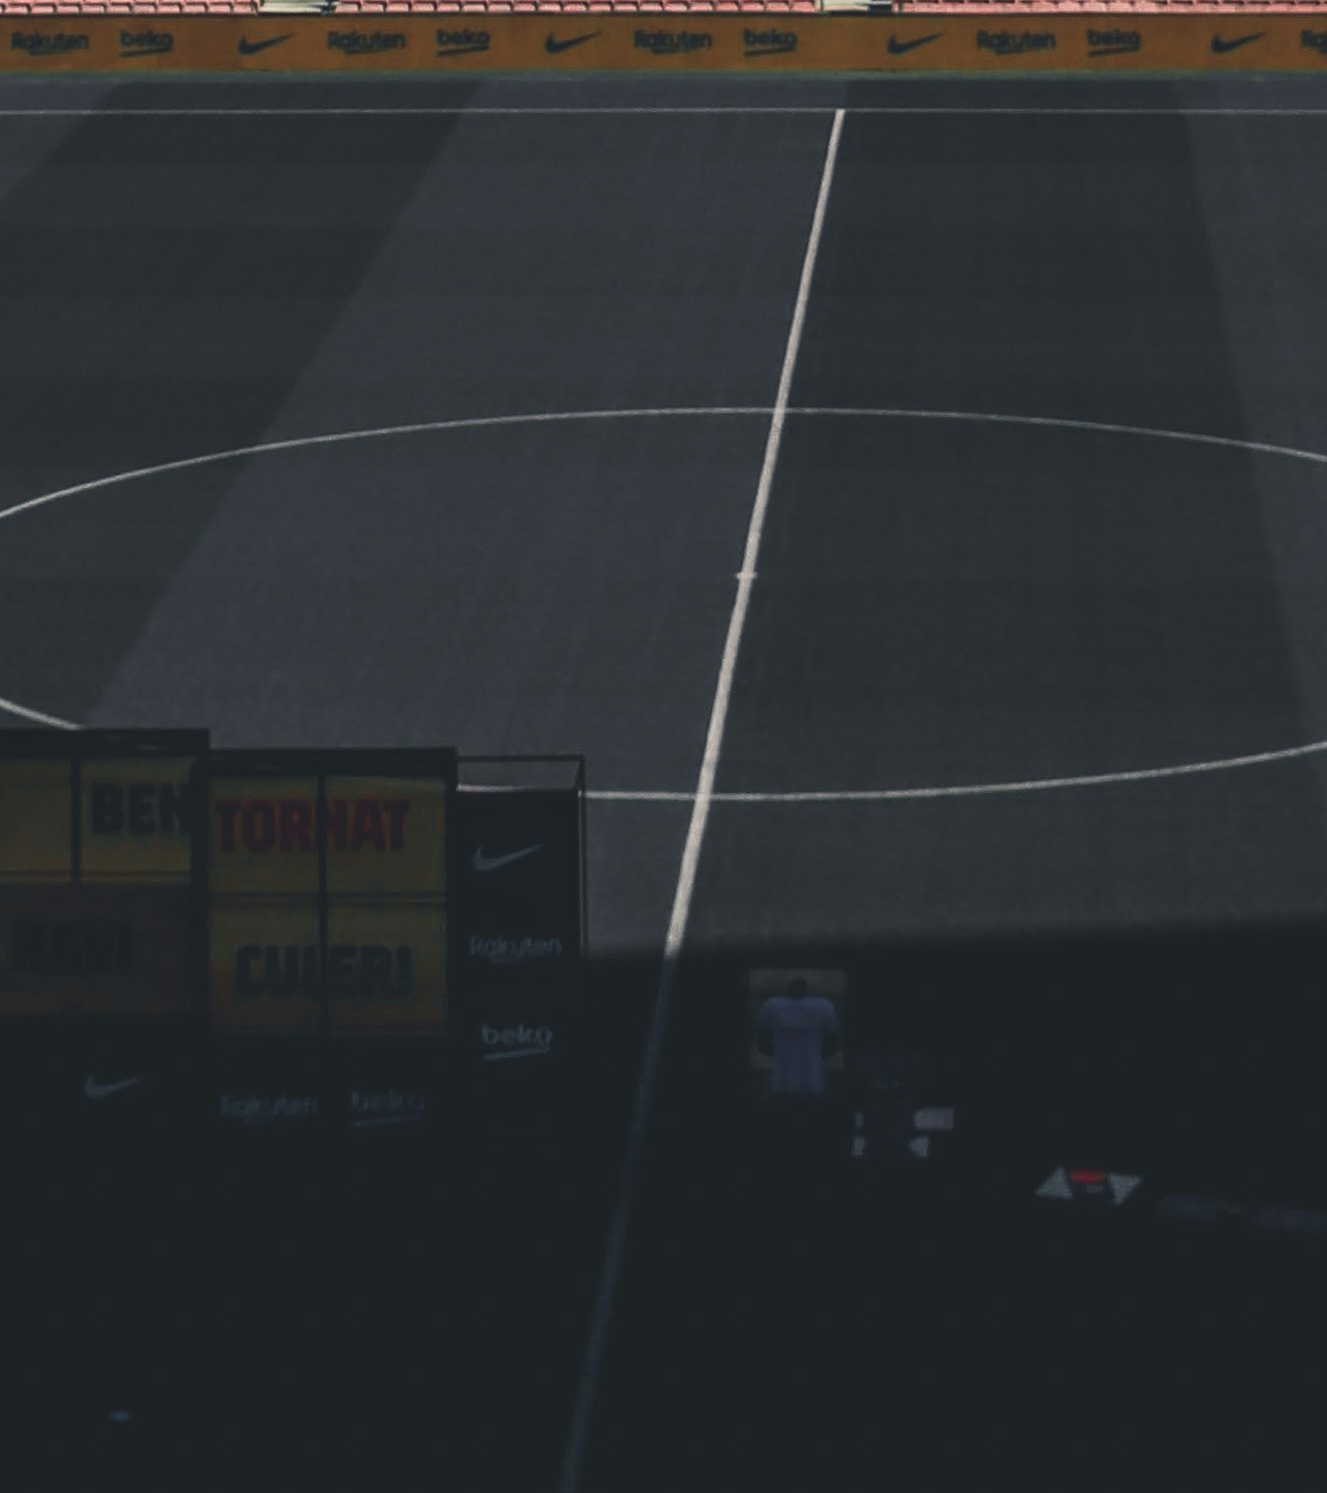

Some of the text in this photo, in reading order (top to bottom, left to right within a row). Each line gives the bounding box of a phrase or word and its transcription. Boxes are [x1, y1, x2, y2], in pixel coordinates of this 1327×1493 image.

[214, 798, 411, 852] TORNAT
[234, 945, 414, 999] CULER!
[481, 1023, 554, 1051] beko
